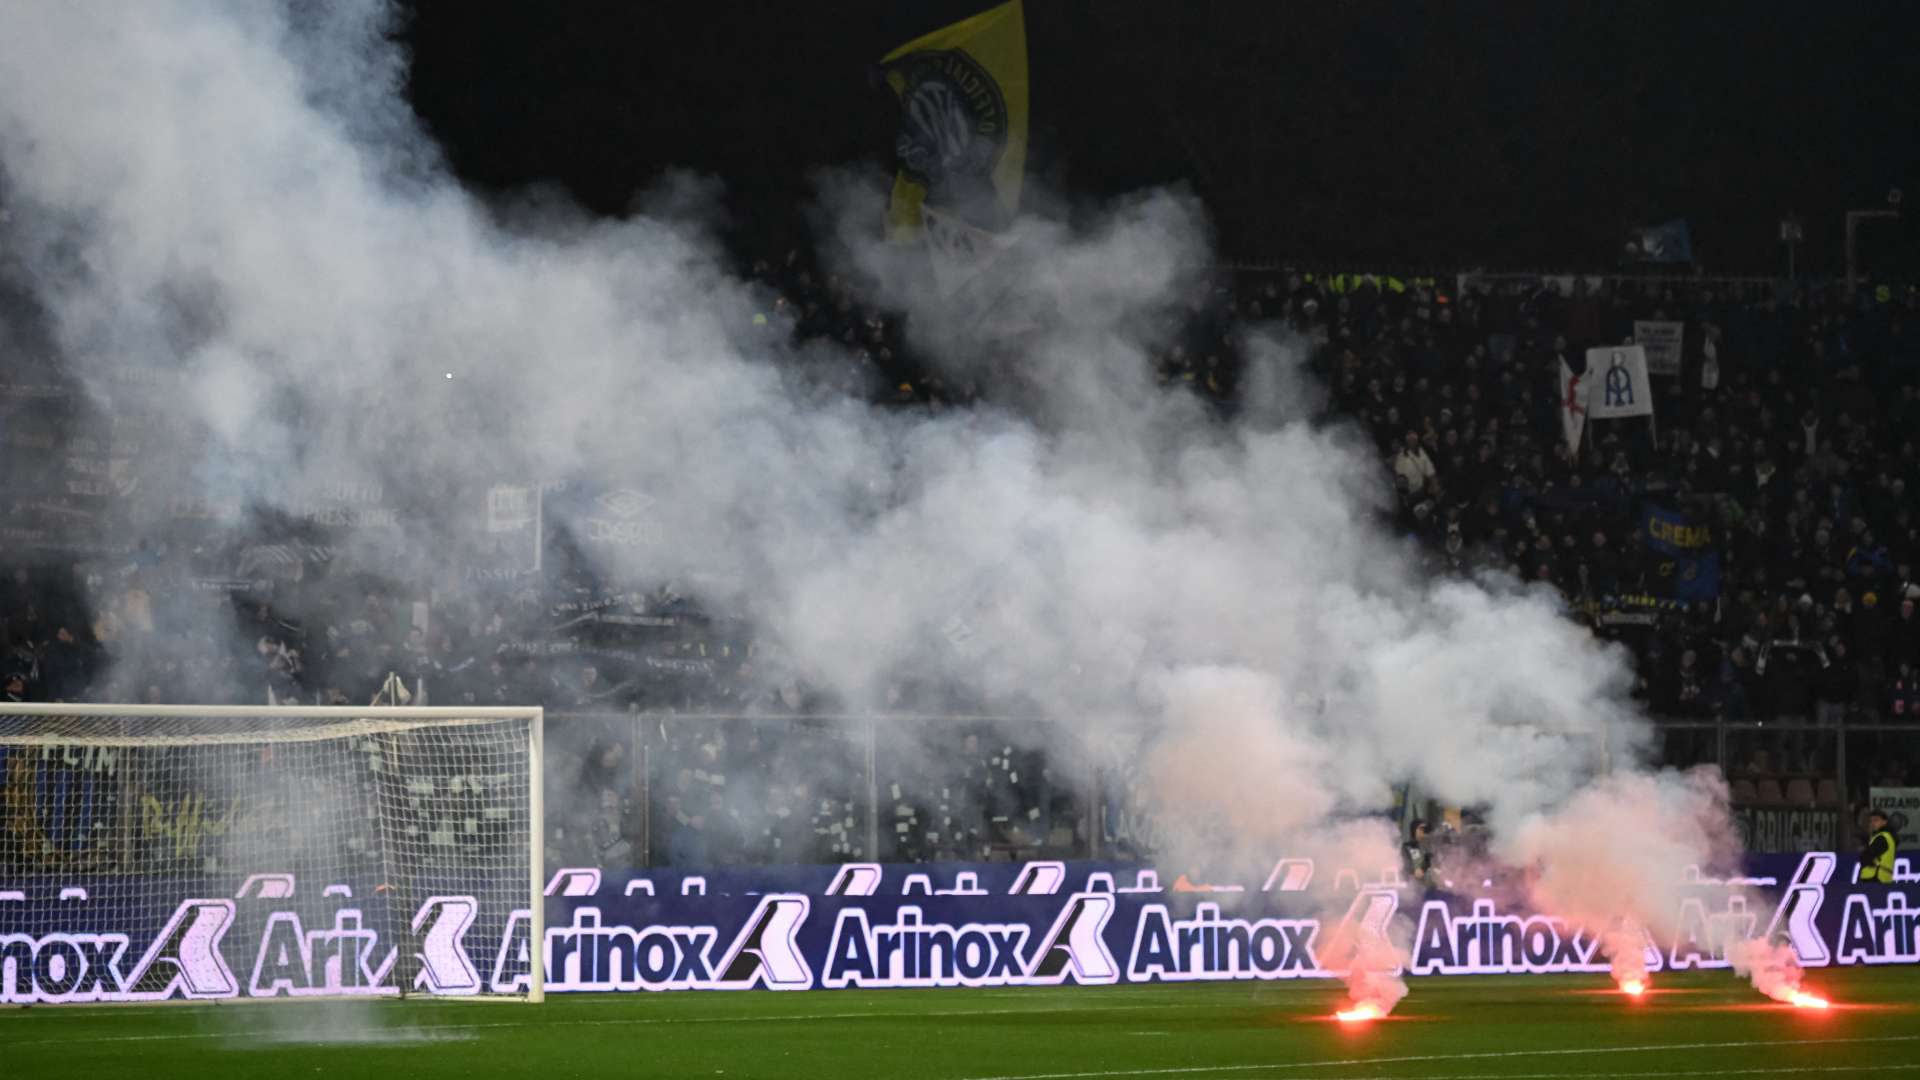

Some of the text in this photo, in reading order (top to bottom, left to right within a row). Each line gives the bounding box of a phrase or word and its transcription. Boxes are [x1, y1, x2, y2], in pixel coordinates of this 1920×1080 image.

[494, 910, 716, 986] Arinox
[826, 909, 1026, 981] Arinox
[1131, 906, 1320, 975] Arinox
[1414, 903, 1585, 969] Arinox
